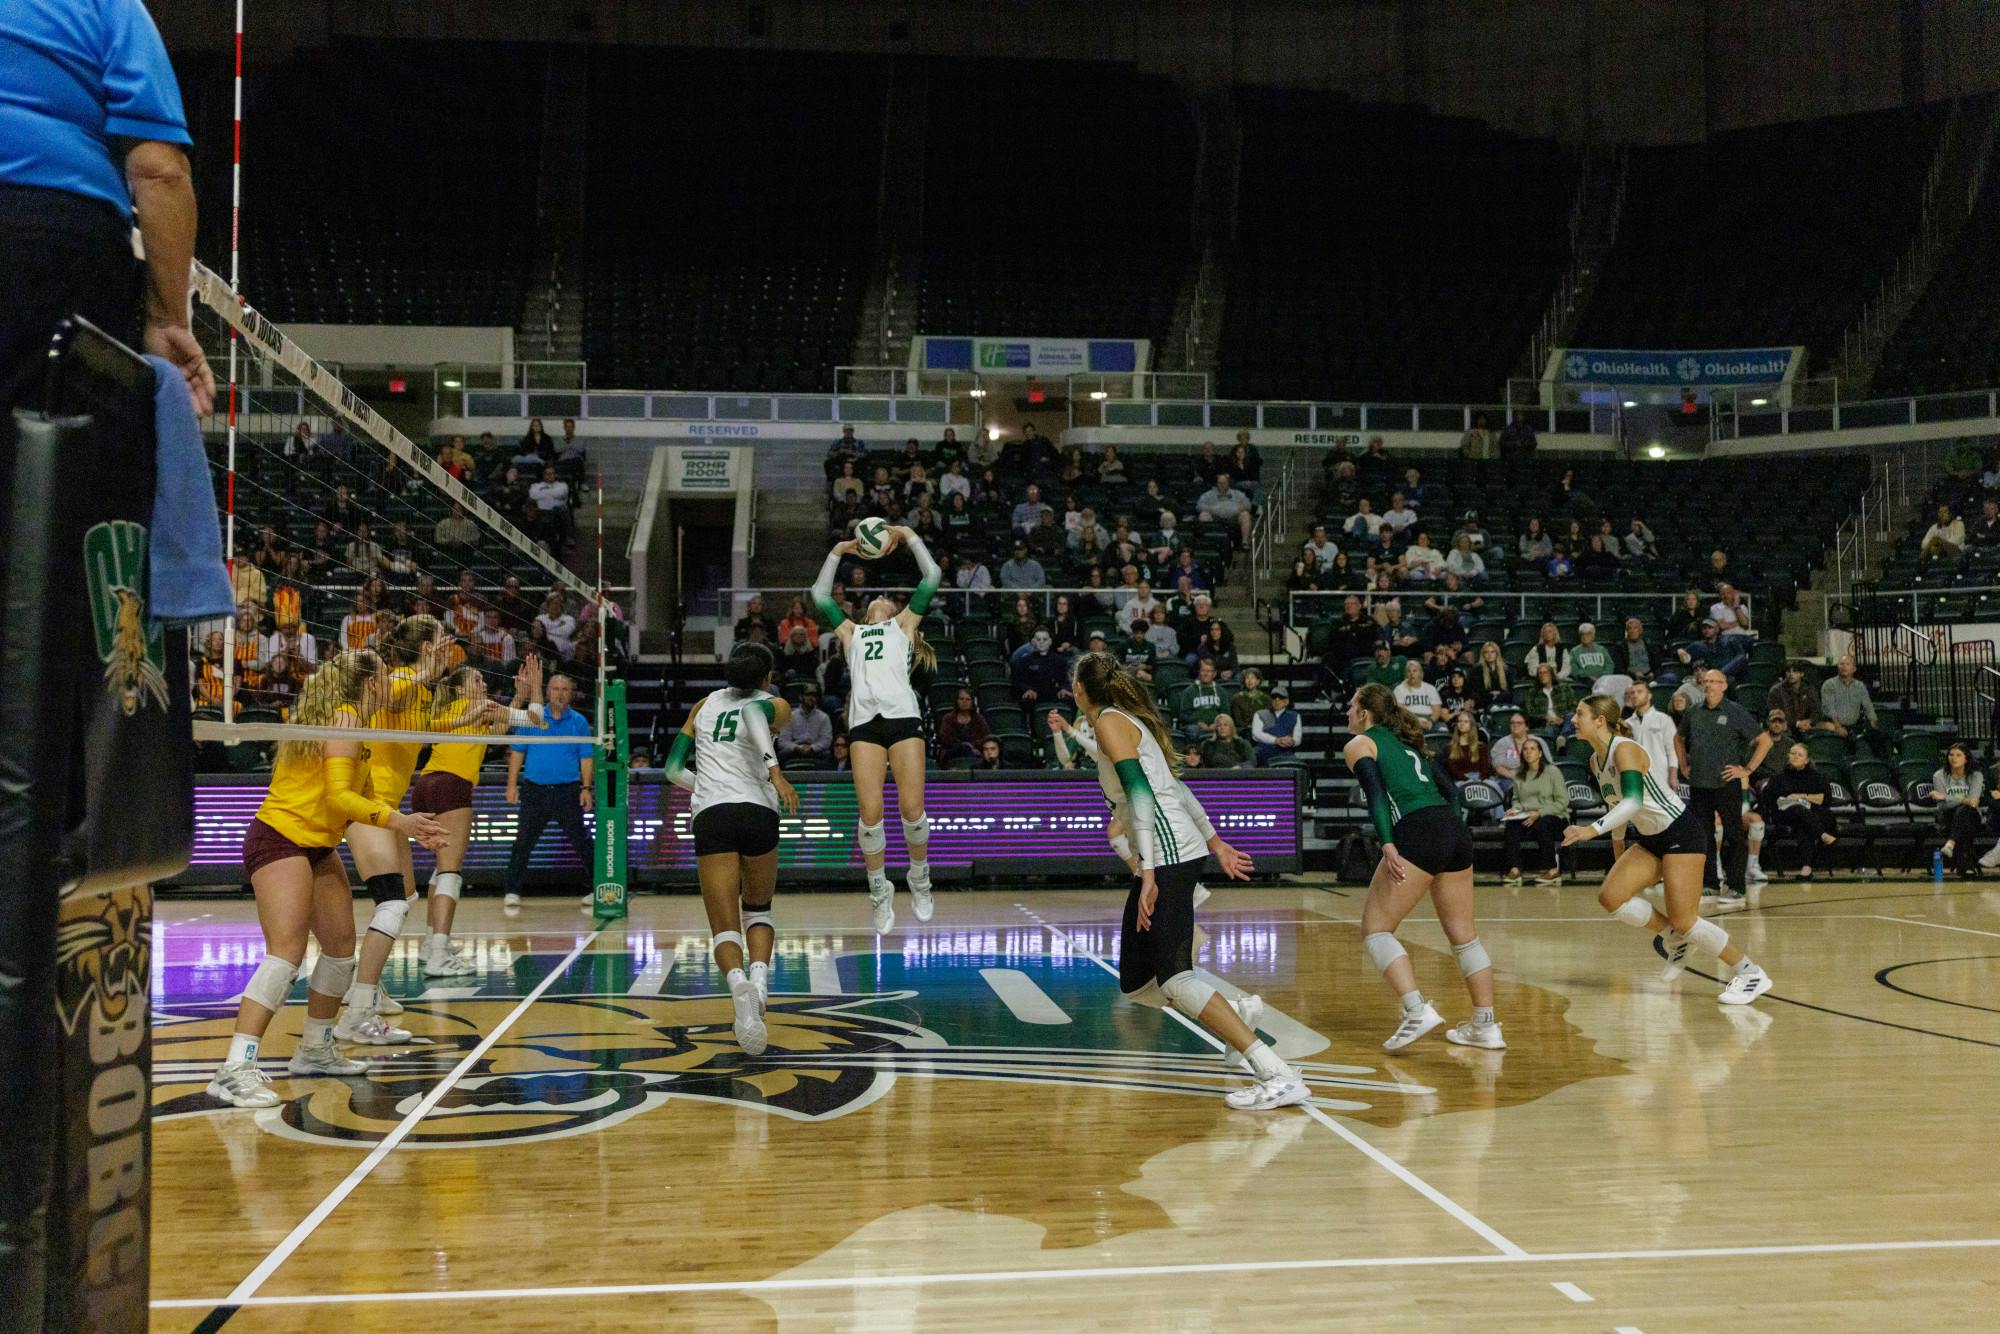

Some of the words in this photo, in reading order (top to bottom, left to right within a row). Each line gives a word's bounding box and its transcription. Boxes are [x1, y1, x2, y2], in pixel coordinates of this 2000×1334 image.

[1591, 361, 1670, 376] OhioHealth
[1704, 360, 1788, 376] OhioHealth
[688, 424, 759, 436] RESERVED
[1294, 433, 1360, 445] RESERED
[685, 461, 727, 469] ROHR
[685, 469, 727, 477] ROOM
[860, 628, 884, 639] OHIO
[864, 640, 884, 661] 22
[712, 708, 740, 743] 15
[1464, 784, 1490, 801] OHIO
[1567, 783, 1593, 801] OHIO
[1866, 783, 1892, 800] OHIO
[606, 819, 615, 846] sports
[606, 846, 615, 878] imports
